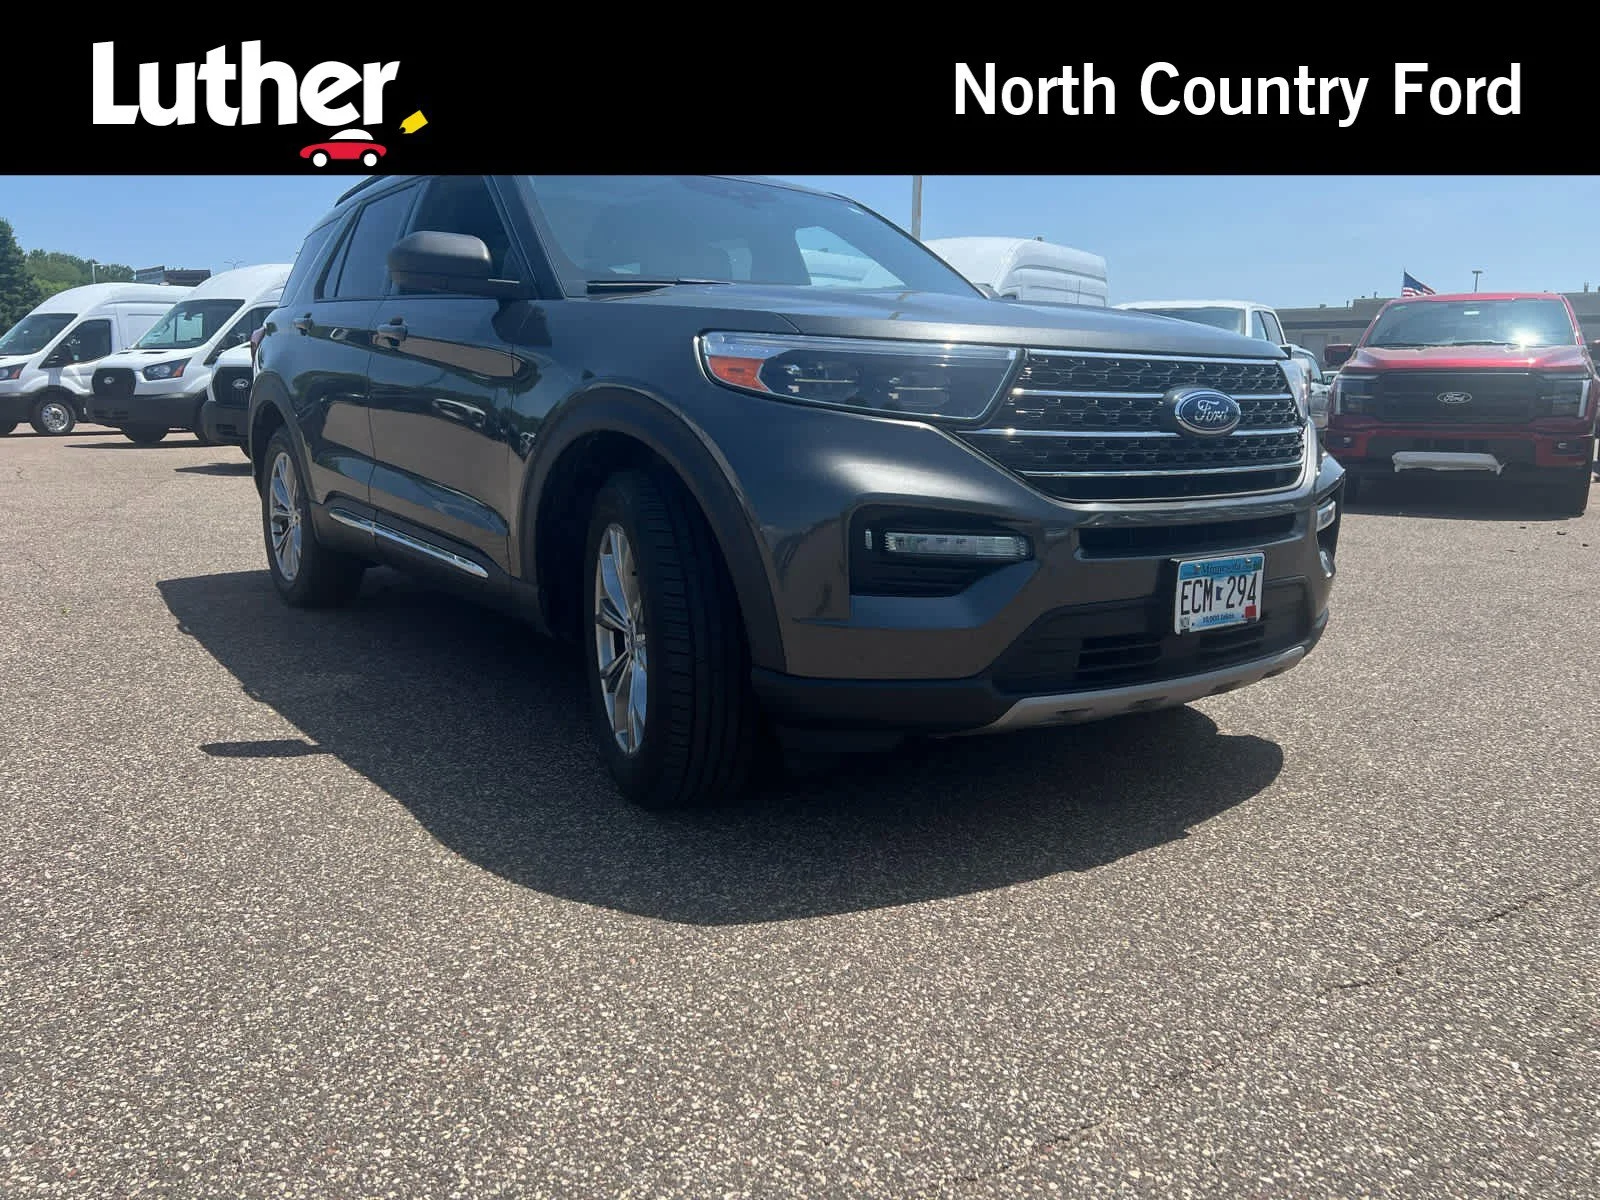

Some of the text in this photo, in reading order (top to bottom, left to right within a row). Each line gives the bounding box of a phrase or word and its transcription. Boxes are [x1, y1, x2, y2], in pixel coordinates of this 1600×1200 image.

[1194, 399, 1230, 421] Ford
[1181, 572, 1258, 616] ECM 294
